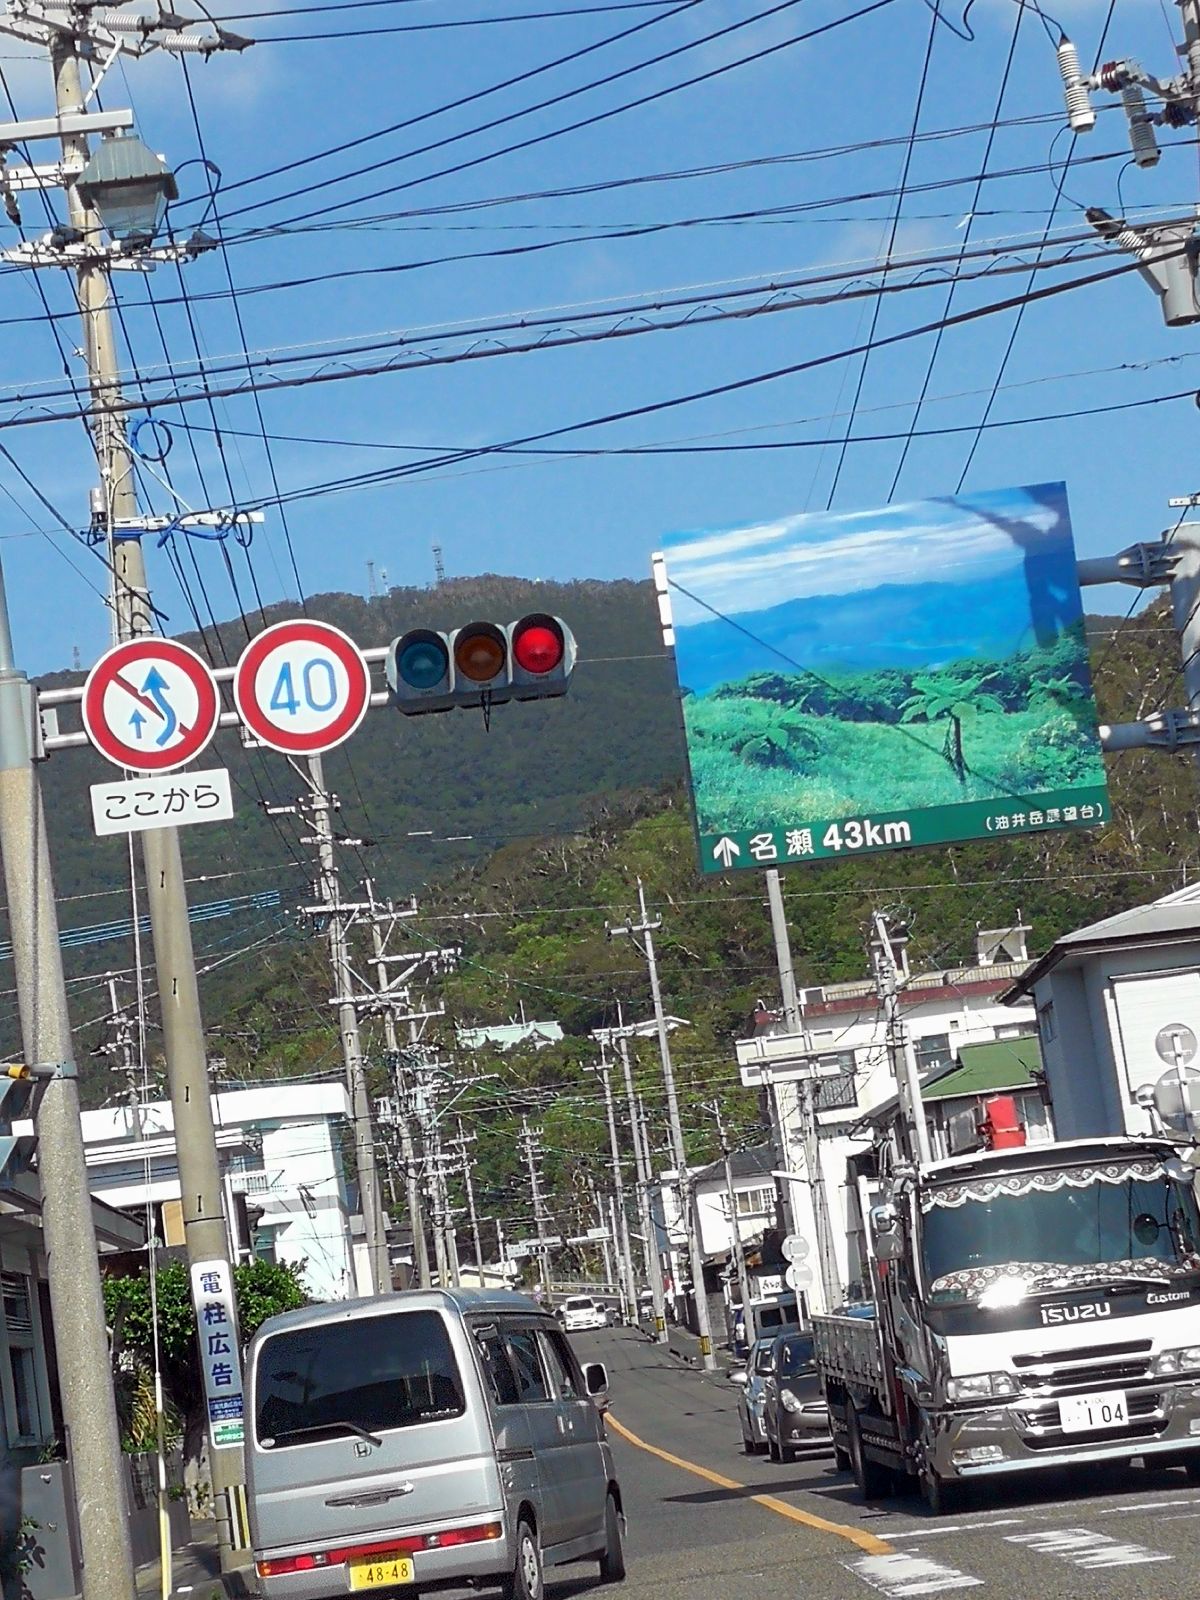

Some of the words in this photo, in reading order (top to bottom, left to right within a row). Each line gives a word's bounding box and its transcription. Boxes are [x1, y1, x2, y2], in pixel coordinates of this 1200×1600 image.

[270, 658, 338, 715] 40
[105, 784, 220, 820] ここから
[822, 819, 911, 851] 43km
[1040, 1301, 1111, 1325] ISUZU
[1146, 1291, 1190, 1304] Custom
[200, 1271, 233, 1387] 電柱広告
[366, 1562, 409, 1584] 48-48
